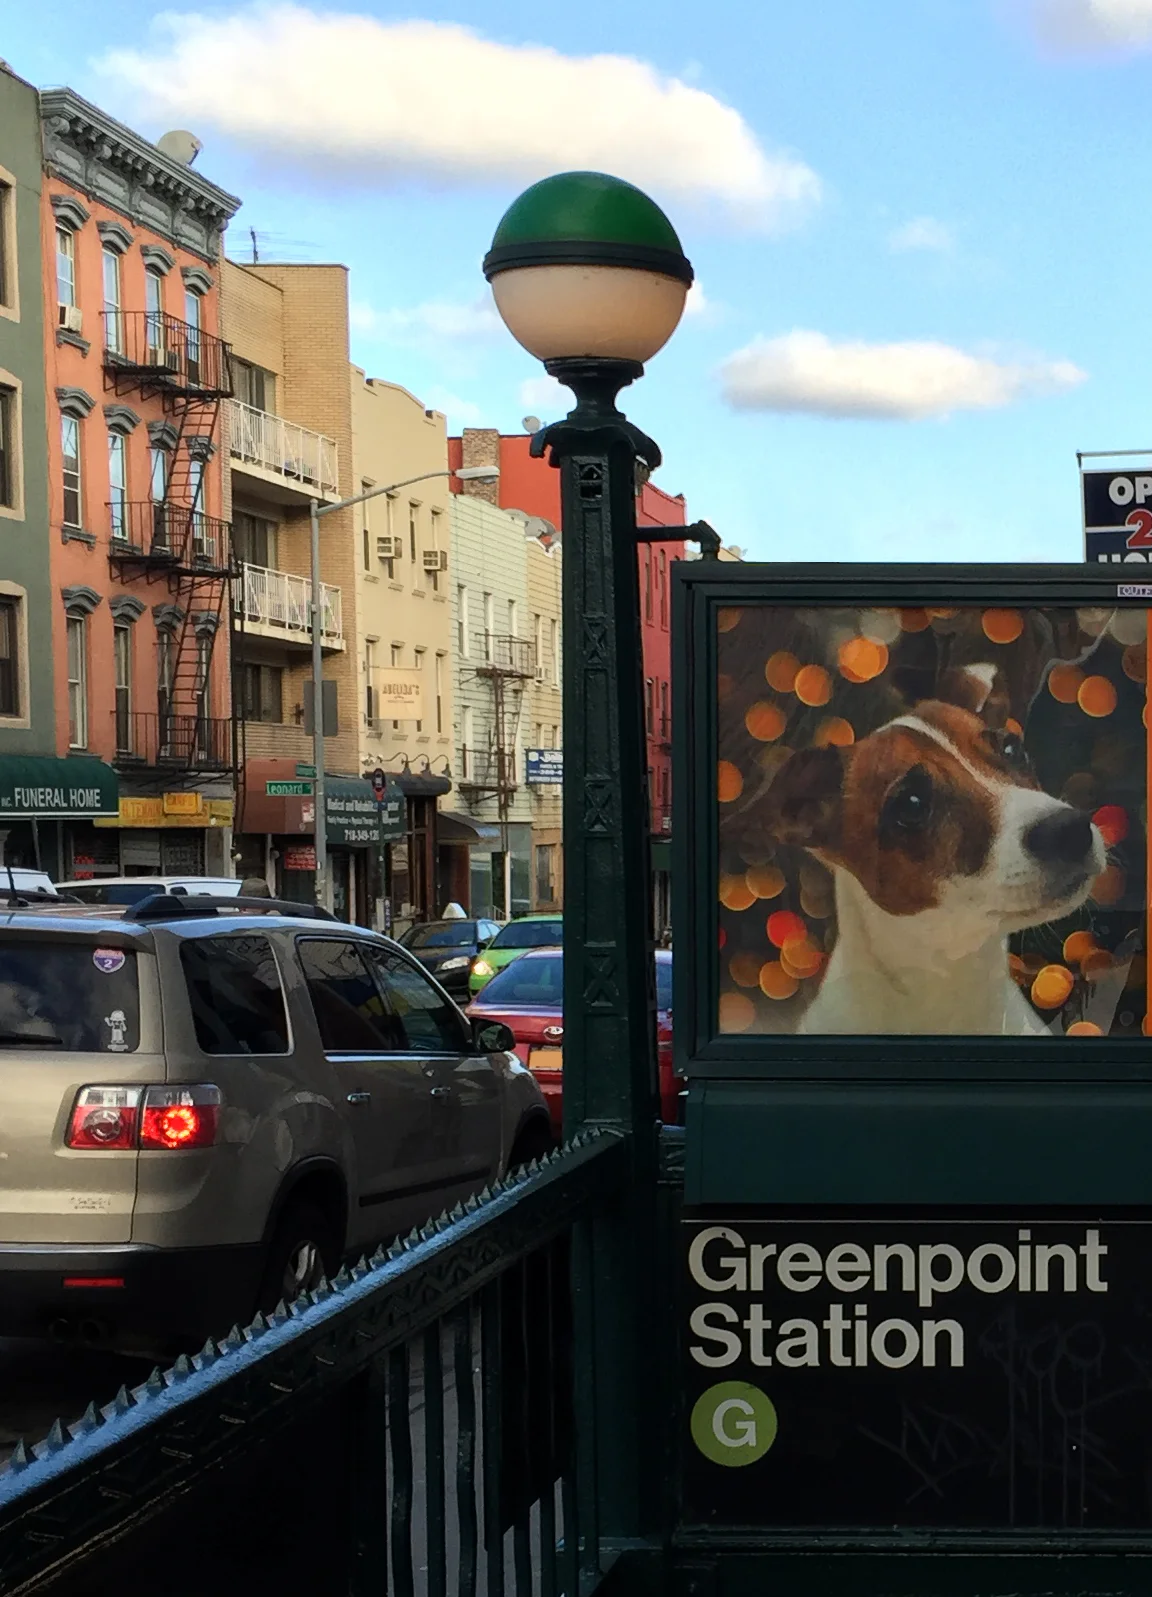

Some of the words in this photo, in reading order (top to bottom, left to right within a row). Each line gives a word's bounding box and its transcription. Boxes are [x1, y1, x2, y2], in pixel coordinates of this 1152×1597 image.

[14, 788, 67, 808] FUNERAL
[69, 788, 101, 808] HOME
[267, 783, 303, 795] Leonard
[104, 959, 113, 969] 2
[688, 1226, 1108, 1307] Greenpoint
[689, 1302, 965, 1369] Station
[711, 1399, 757, 1447] G
